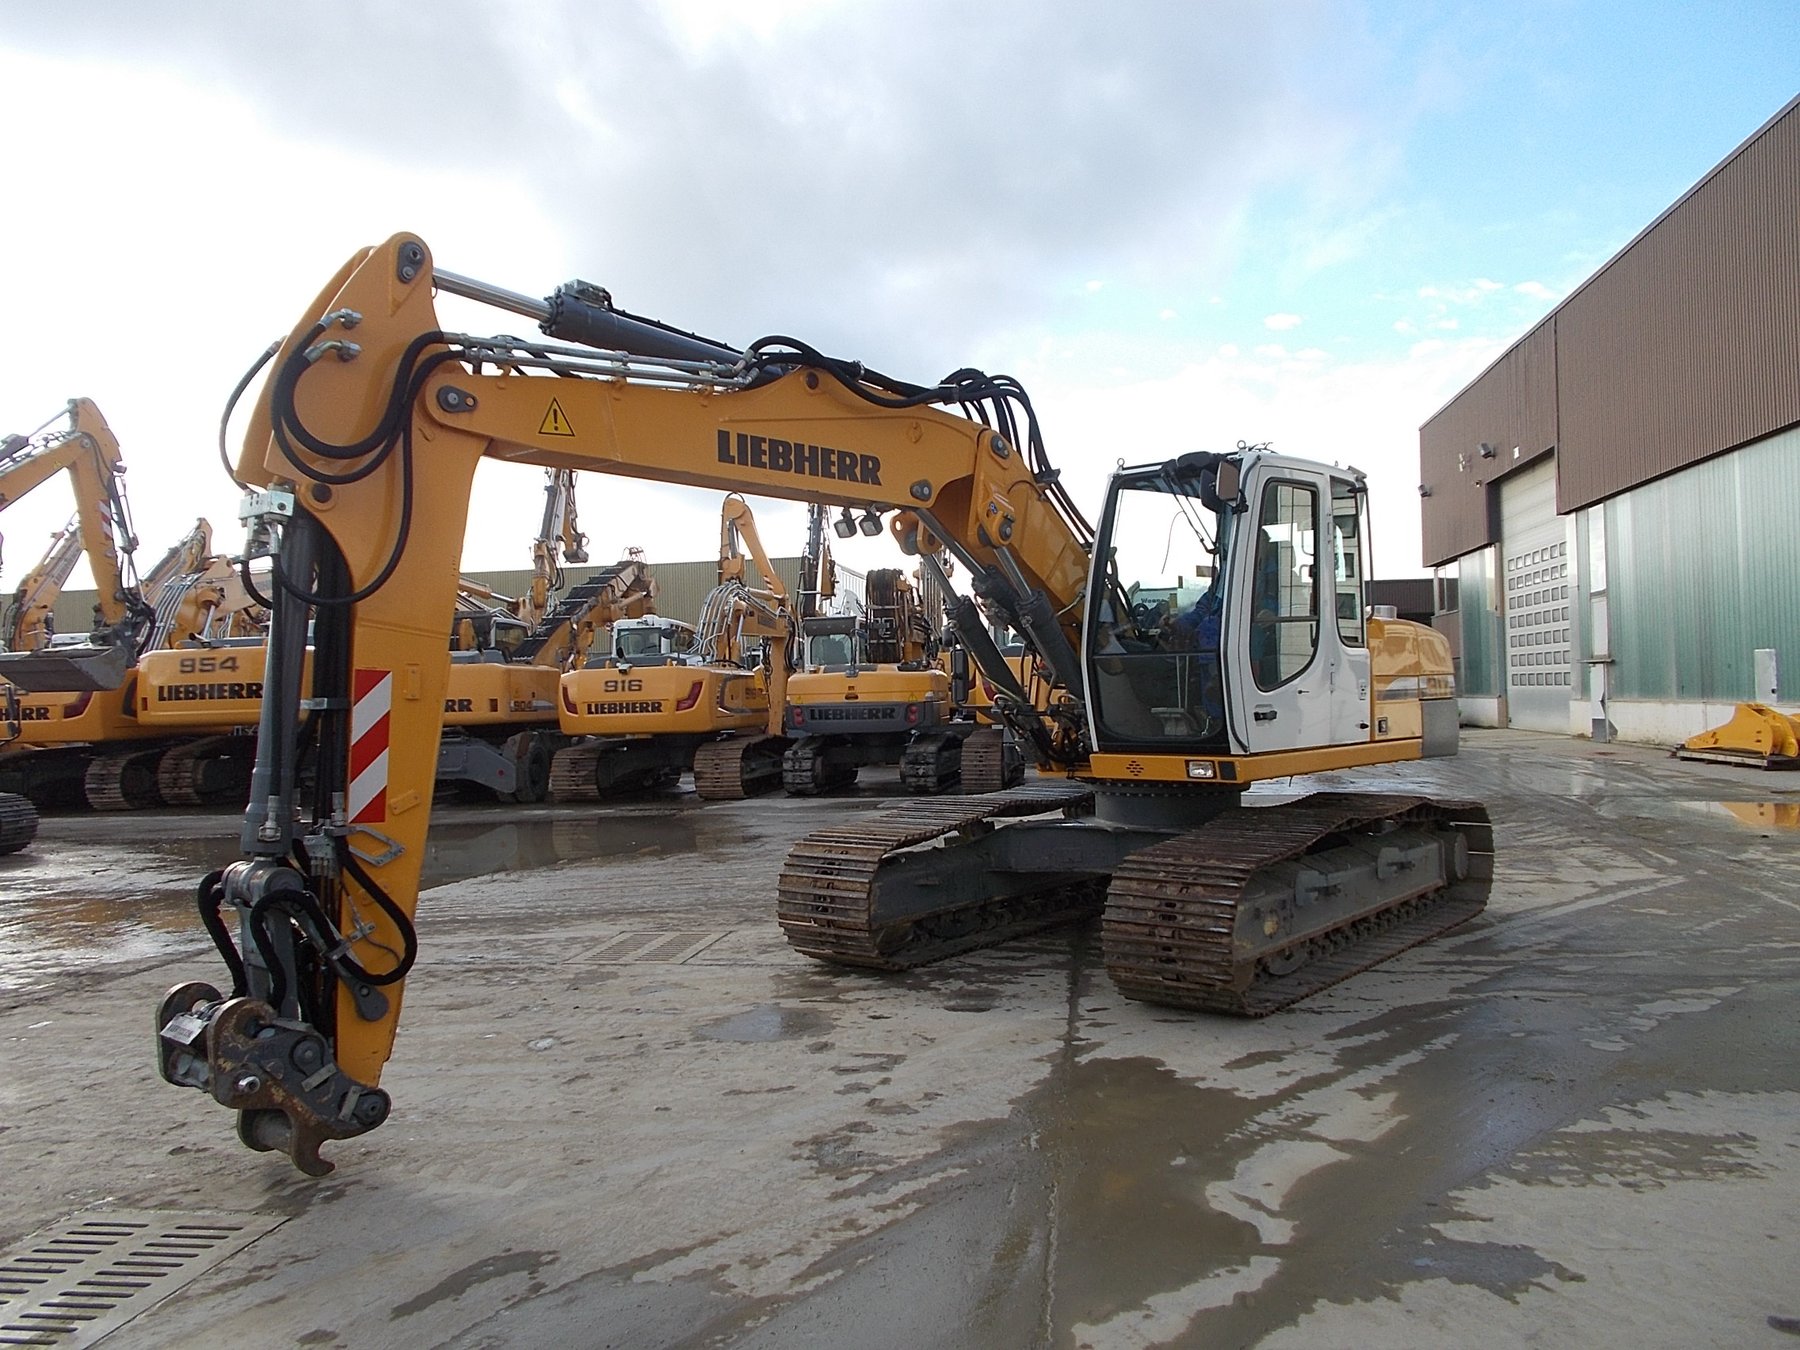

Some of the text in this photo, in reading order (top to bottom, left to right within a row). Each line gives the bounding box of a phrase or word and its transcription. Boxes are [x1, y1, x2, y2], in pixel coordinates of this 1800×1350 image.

[717, 429, 882, 486] LIEBHERR
[179, 656, 240, 674] 954
[157, 683, 263, 701] LIEBHERR
[604, 679, 643, 692] 916
[586, 701, 663, 715] LIEBHERR
[809, 707, 896, 721] LIEBHERR
